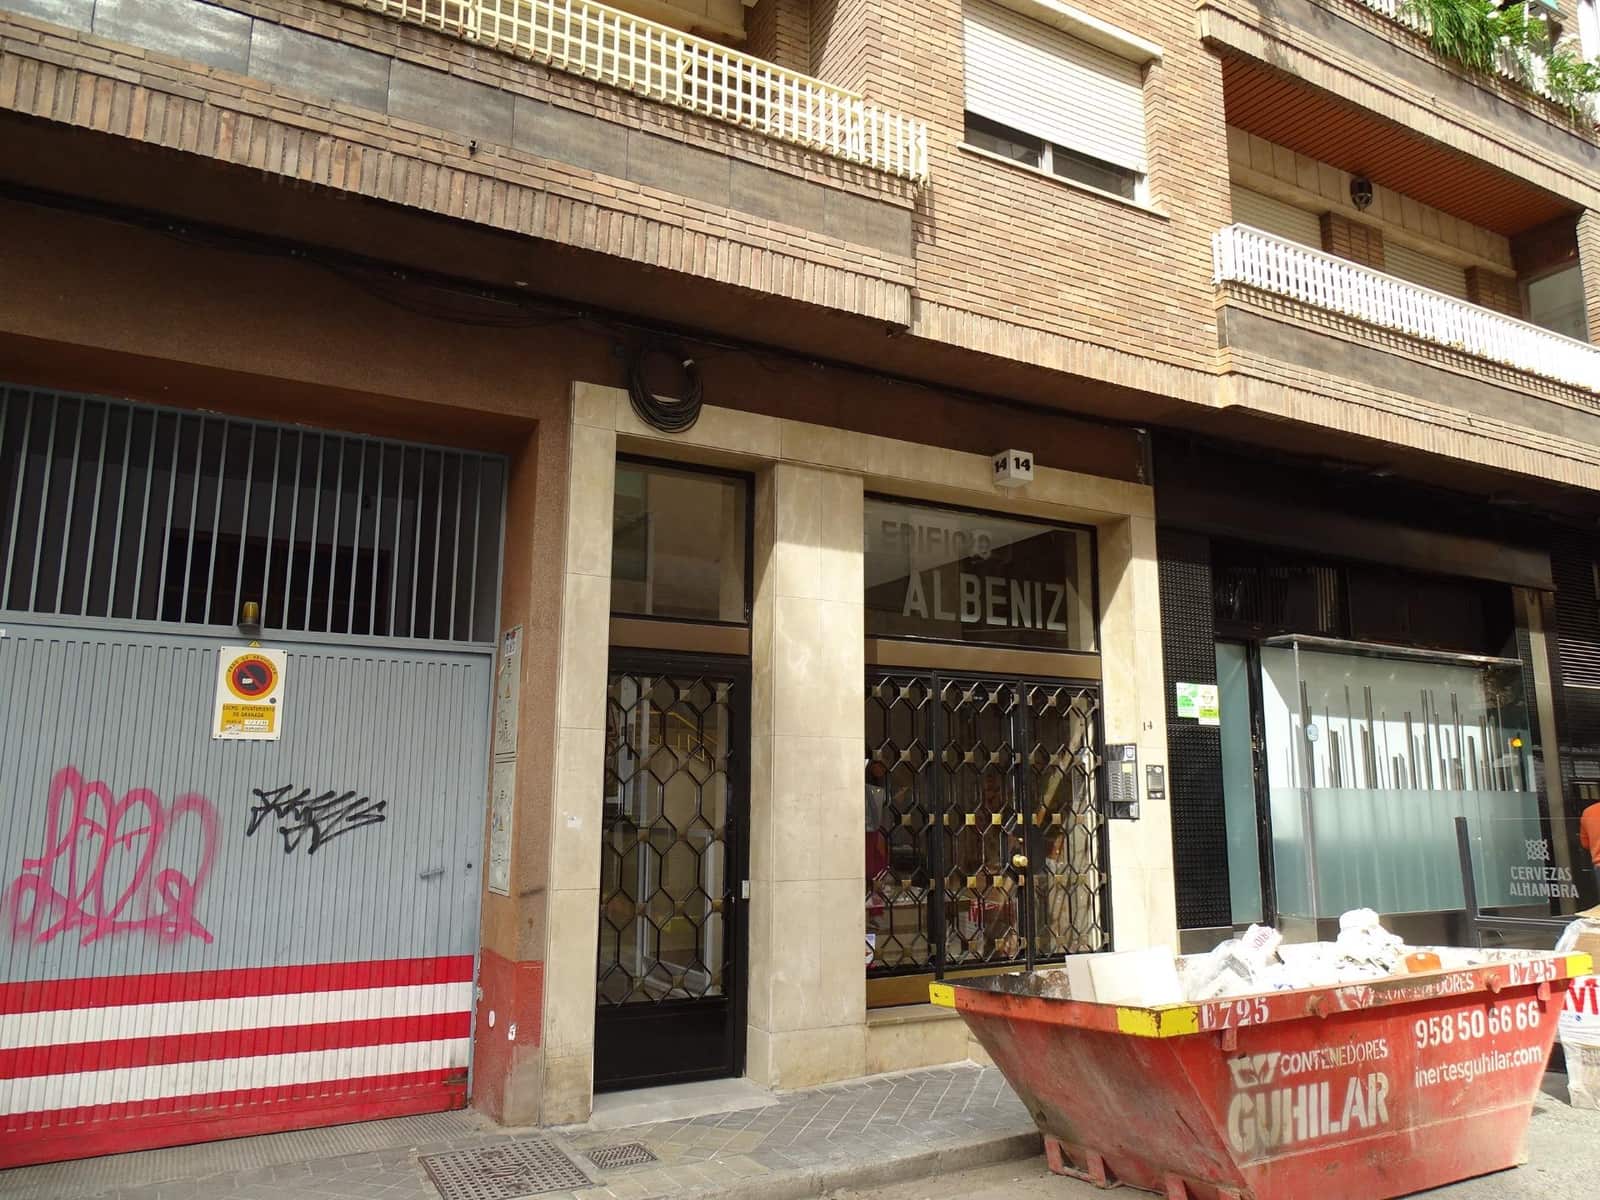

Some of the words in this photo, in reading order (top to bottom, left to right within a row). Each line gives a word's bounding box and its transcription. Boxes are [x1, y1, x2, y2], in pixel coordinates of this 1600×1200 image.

[994, 457, 1008, 473] 14
[1013, 456, 1031, 471] 14
[902, 569, 1067, 632] ALBENIZ
[1509, 882, 1580, 899] ALHAMBRA
[1511, 866, 1573, 882] CERVEZAS
[1415, 1014, 1455, 1049] 958
[1457, 1009, 1485, 1040] 50
[1488, 1004, 1513, 1035] 66
[1515, 1000, 1540, 1031] 66
[1280, 1038, 1389, 1076] CONTENEDORES
[1415, 1044, 1542, 1089] inertesguhilar.com
[1227, 1071, 1390, 1153] GUHILAR
